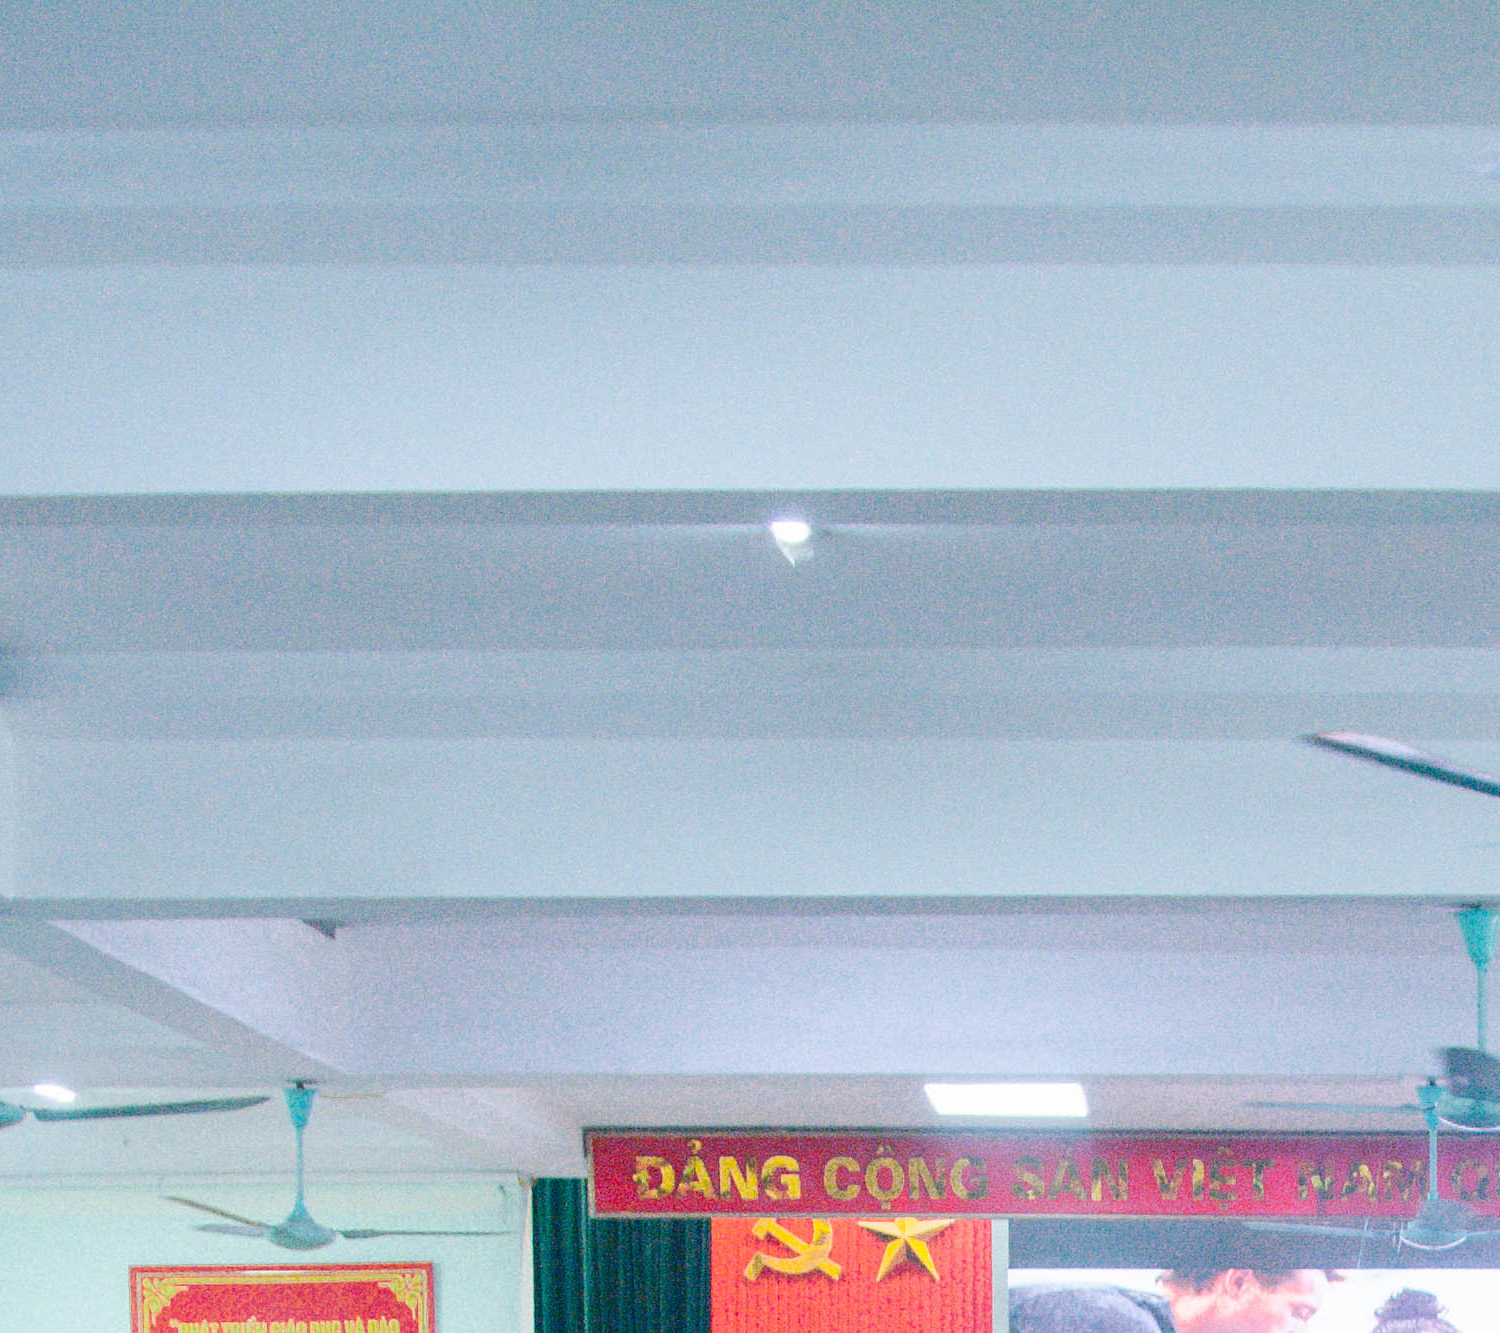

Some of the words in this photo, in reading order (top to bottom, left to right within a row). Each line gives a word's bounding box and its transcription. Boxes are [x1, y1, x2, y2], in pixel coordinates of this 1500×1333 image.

[633, 1139, 802, 1201] ĐẢNG
[823, 1144, 988, 1210] CỘNG
[1153, 1146, 1274, 1209] VIỆT
[1298, 1160, 1429, 1201] NAM
